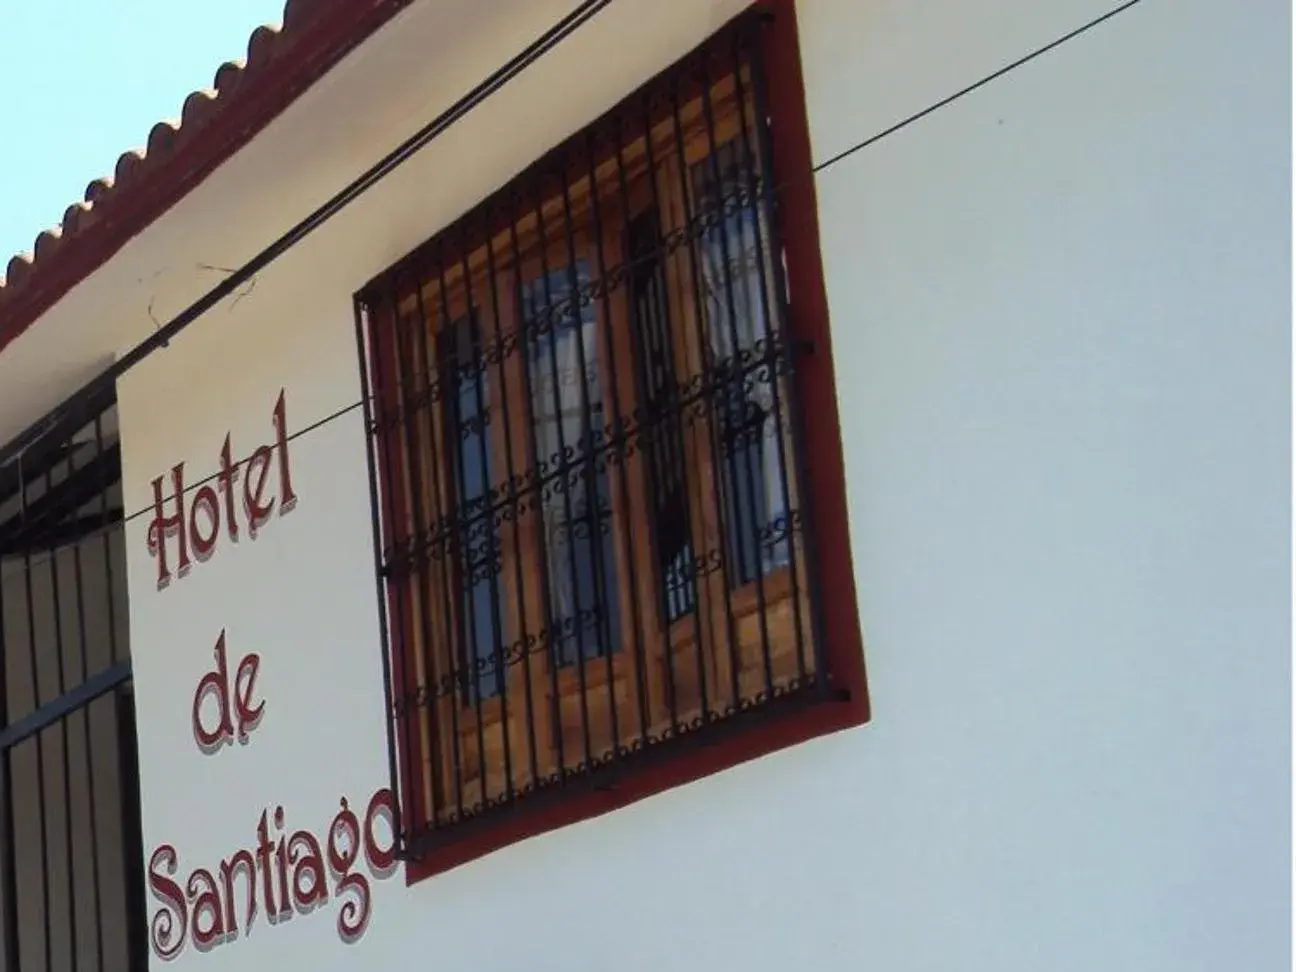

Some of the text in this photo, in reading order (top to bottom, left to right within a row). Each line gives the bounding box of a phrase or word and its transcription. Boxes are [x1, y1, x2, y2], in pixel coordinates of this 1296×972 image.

[147, 387, 298, 592] Hotel
[191, 626, 266, 757] de
[147, 787, 402, 963] Santiago
